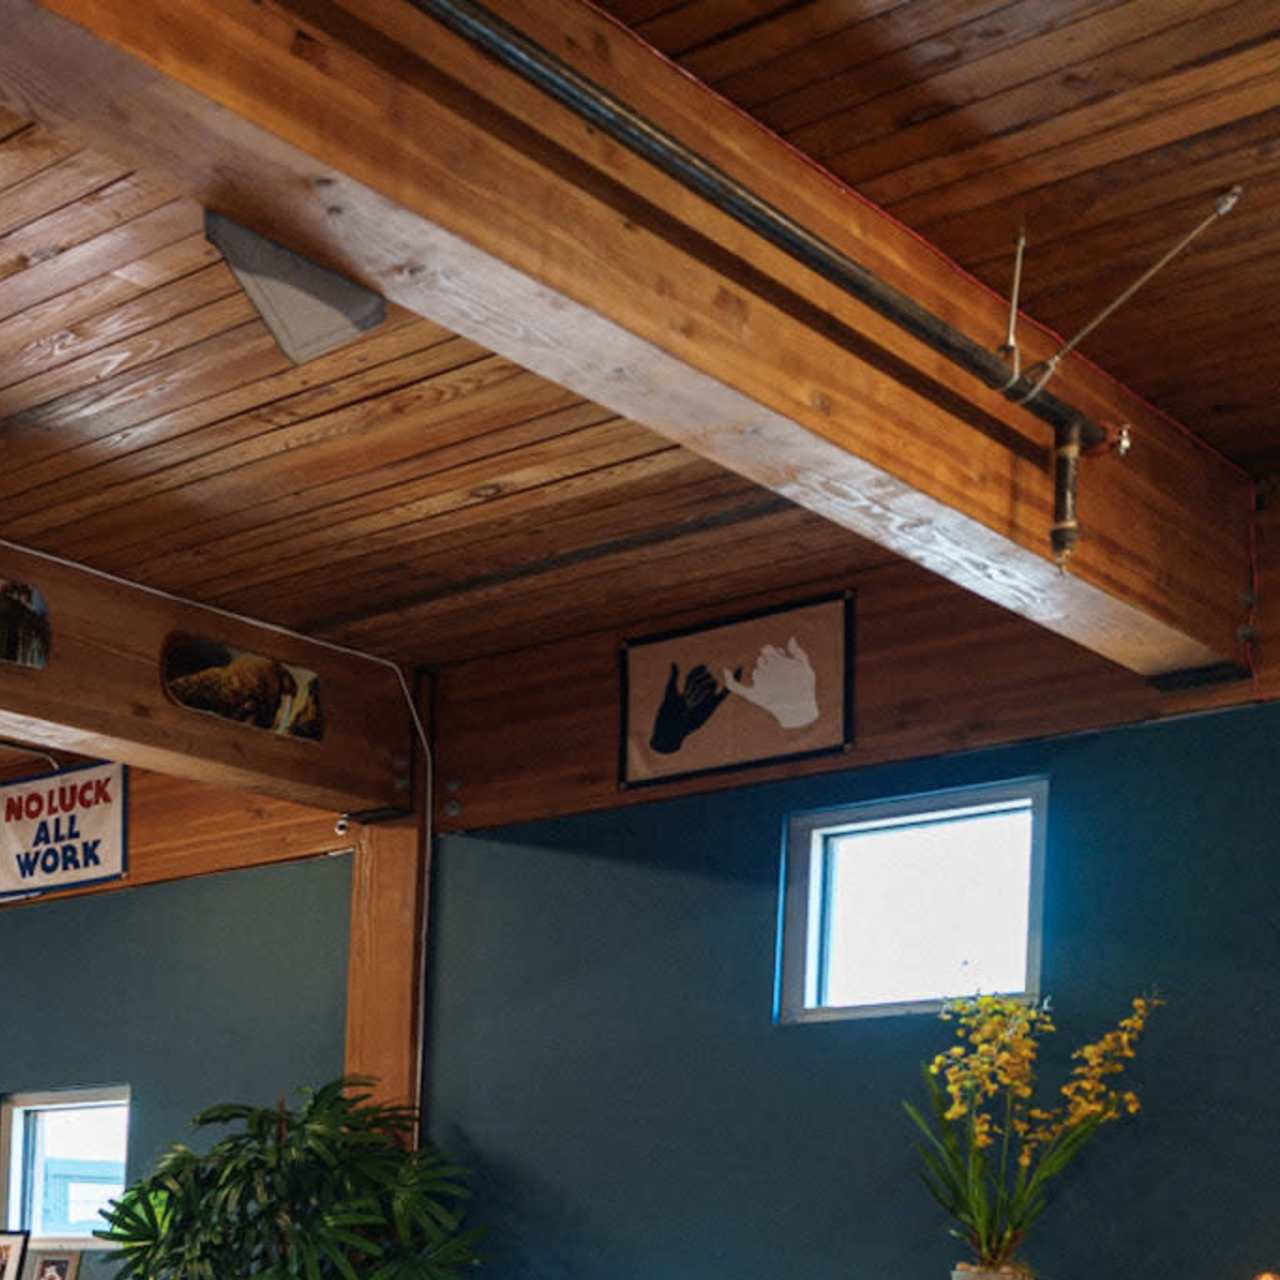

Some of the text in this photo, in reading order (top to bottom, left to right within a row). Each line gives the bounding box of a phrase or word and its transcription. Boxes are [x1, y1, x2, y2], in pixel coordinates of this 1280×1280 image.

[47, 777, 112, 816] LUCK
[32, 815, 80, 847] ALL
[16, 839, 101, 879] WORK
